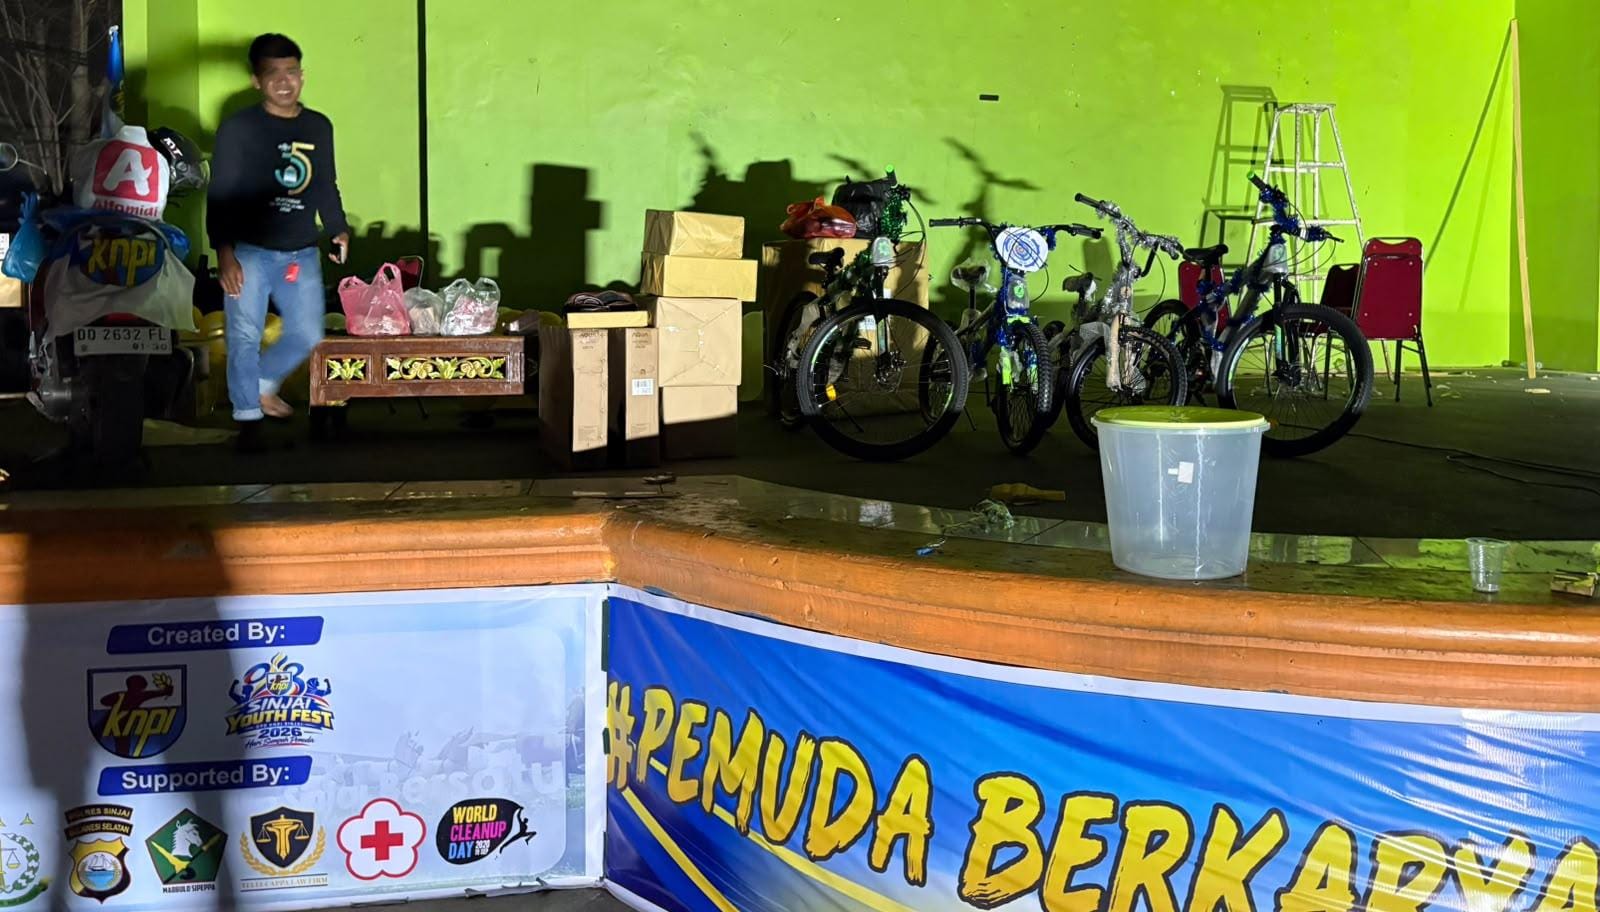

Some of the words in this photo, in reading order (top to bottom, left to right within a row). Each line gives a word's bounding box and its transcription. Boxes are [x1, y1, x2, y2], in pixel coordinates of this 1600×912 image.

[77, 328, 96, 341] DD
[103, 328, 141, 341] 2632
[148, 328, 167, 341] FL
[147, 623, 240, 646] Created
[248, 622, 286, 644] By:
[247, 697, 312, 713] SINJAI
[102, 692, 176, 757] knpi
[226, 711, 285, 733] YOUTH
[291, 709, 333, 728] FEST
[259, 727, 302, 739] 2026
[122, 766, 244, 791] Supported
[252, 764, 290, 784] By:
[607, 681, 932, 887] #PEMUDA
[453, 804, 498, 824] WORLD
[450, 821, 507, 842] CLEANUP
[448, 841, 475, 860] DAY
